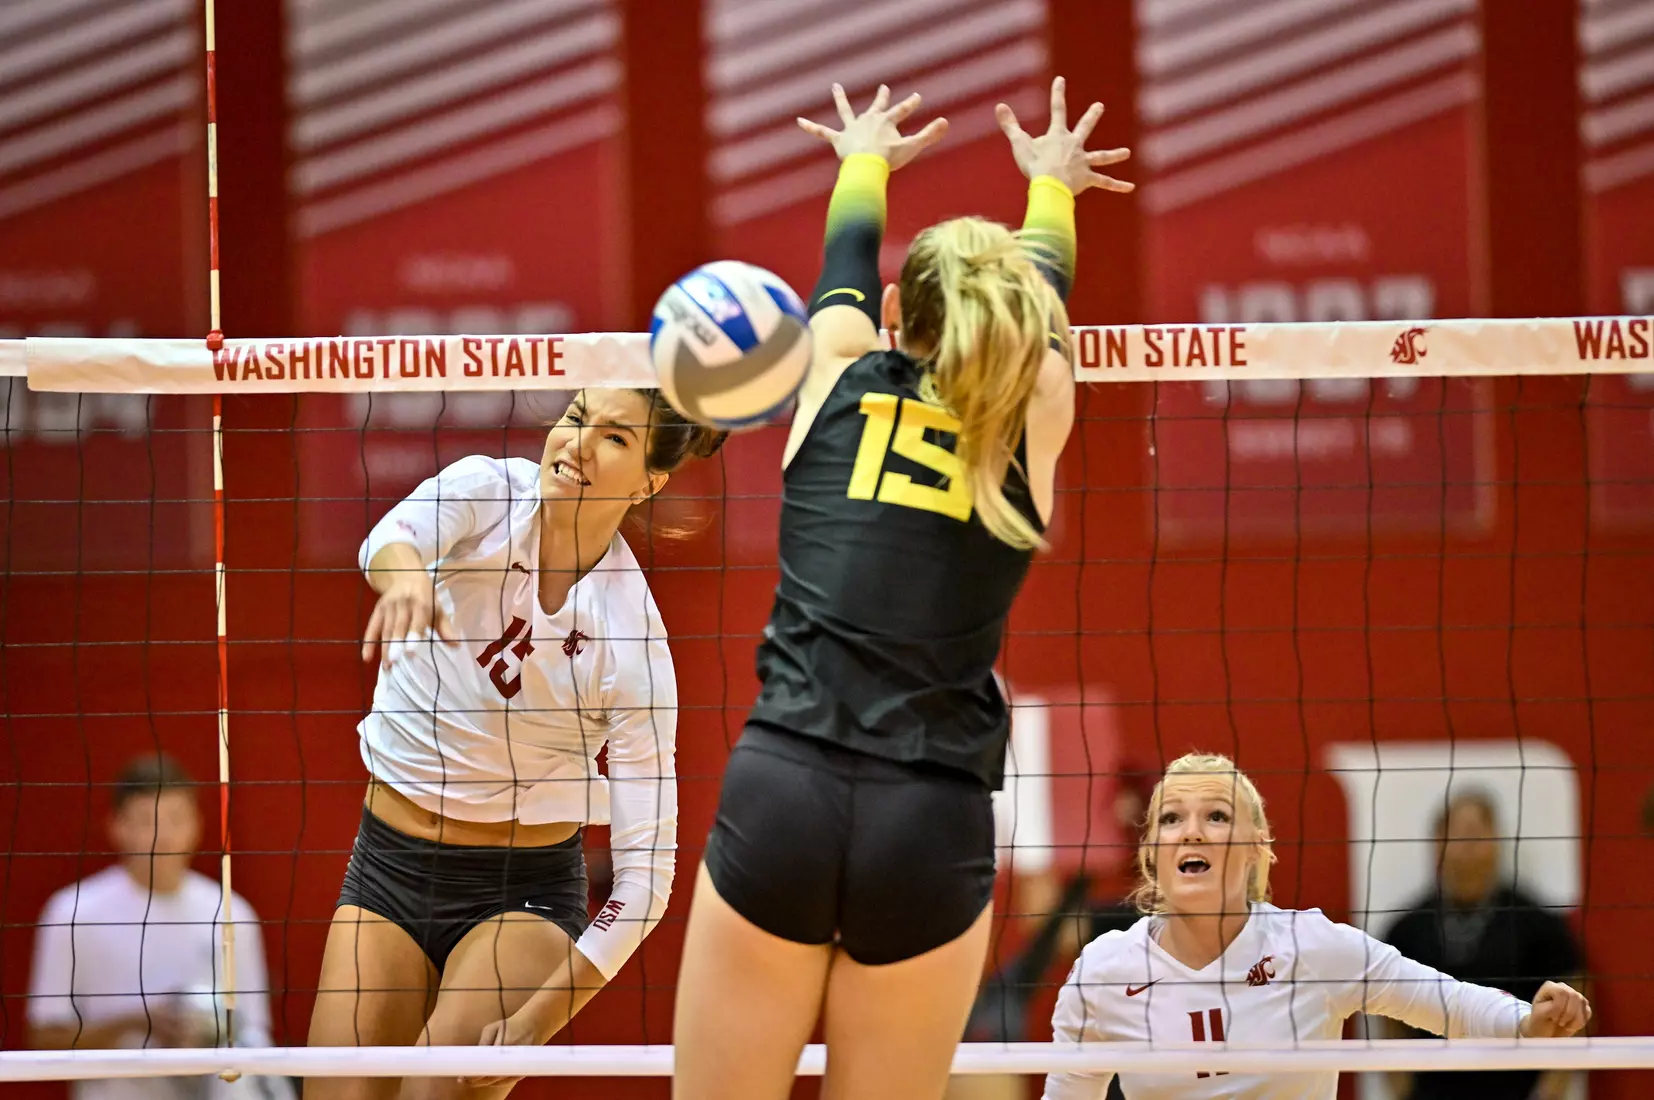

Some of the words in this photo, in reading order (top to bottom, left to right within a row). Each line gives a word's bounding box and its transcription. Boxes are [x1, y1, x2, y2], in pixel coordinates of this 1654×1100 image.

[212, 338, 446, 381] WASHINGTON
[462, 336, 565, 377] STATE
[1071, 328, 1128, 368] ON
[1143, 327, 1247, 367] STATE
[1573, 319, 1654, 360] WAS
[847, 391, 975, 523] 15
[476, 614, 535, 709] 15
[593, 899, 626, 932] WSU
